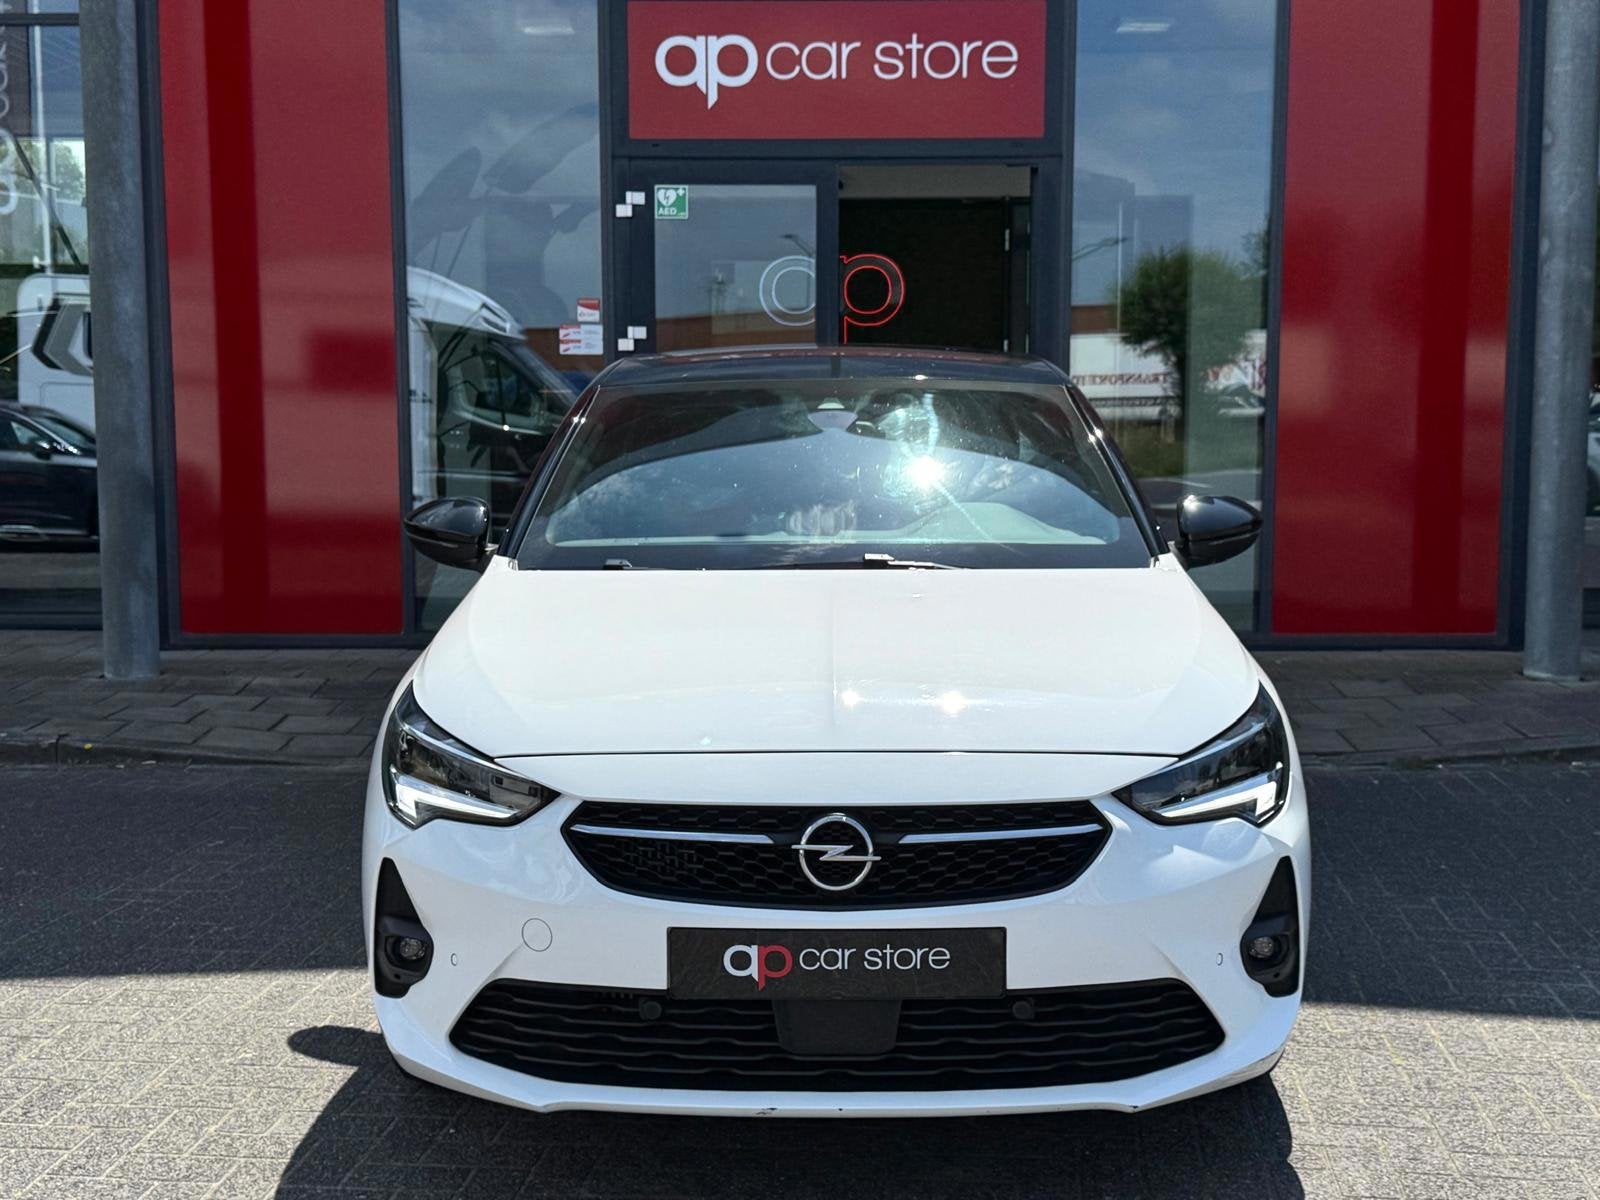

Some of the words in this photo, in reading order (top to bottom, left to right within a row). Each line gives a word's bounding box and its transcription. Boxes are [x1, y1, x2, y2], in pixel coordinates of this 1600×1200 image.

[655, 35, 758, 108] ap
[766, 42, 861, 80] car
[874, 34, 1018, 79] store
[658, 207, 677, 216] AED
[724, 945, 792, 989] ap
[800, 949, 856, 970] car
[864, 944, 950, 970] store
